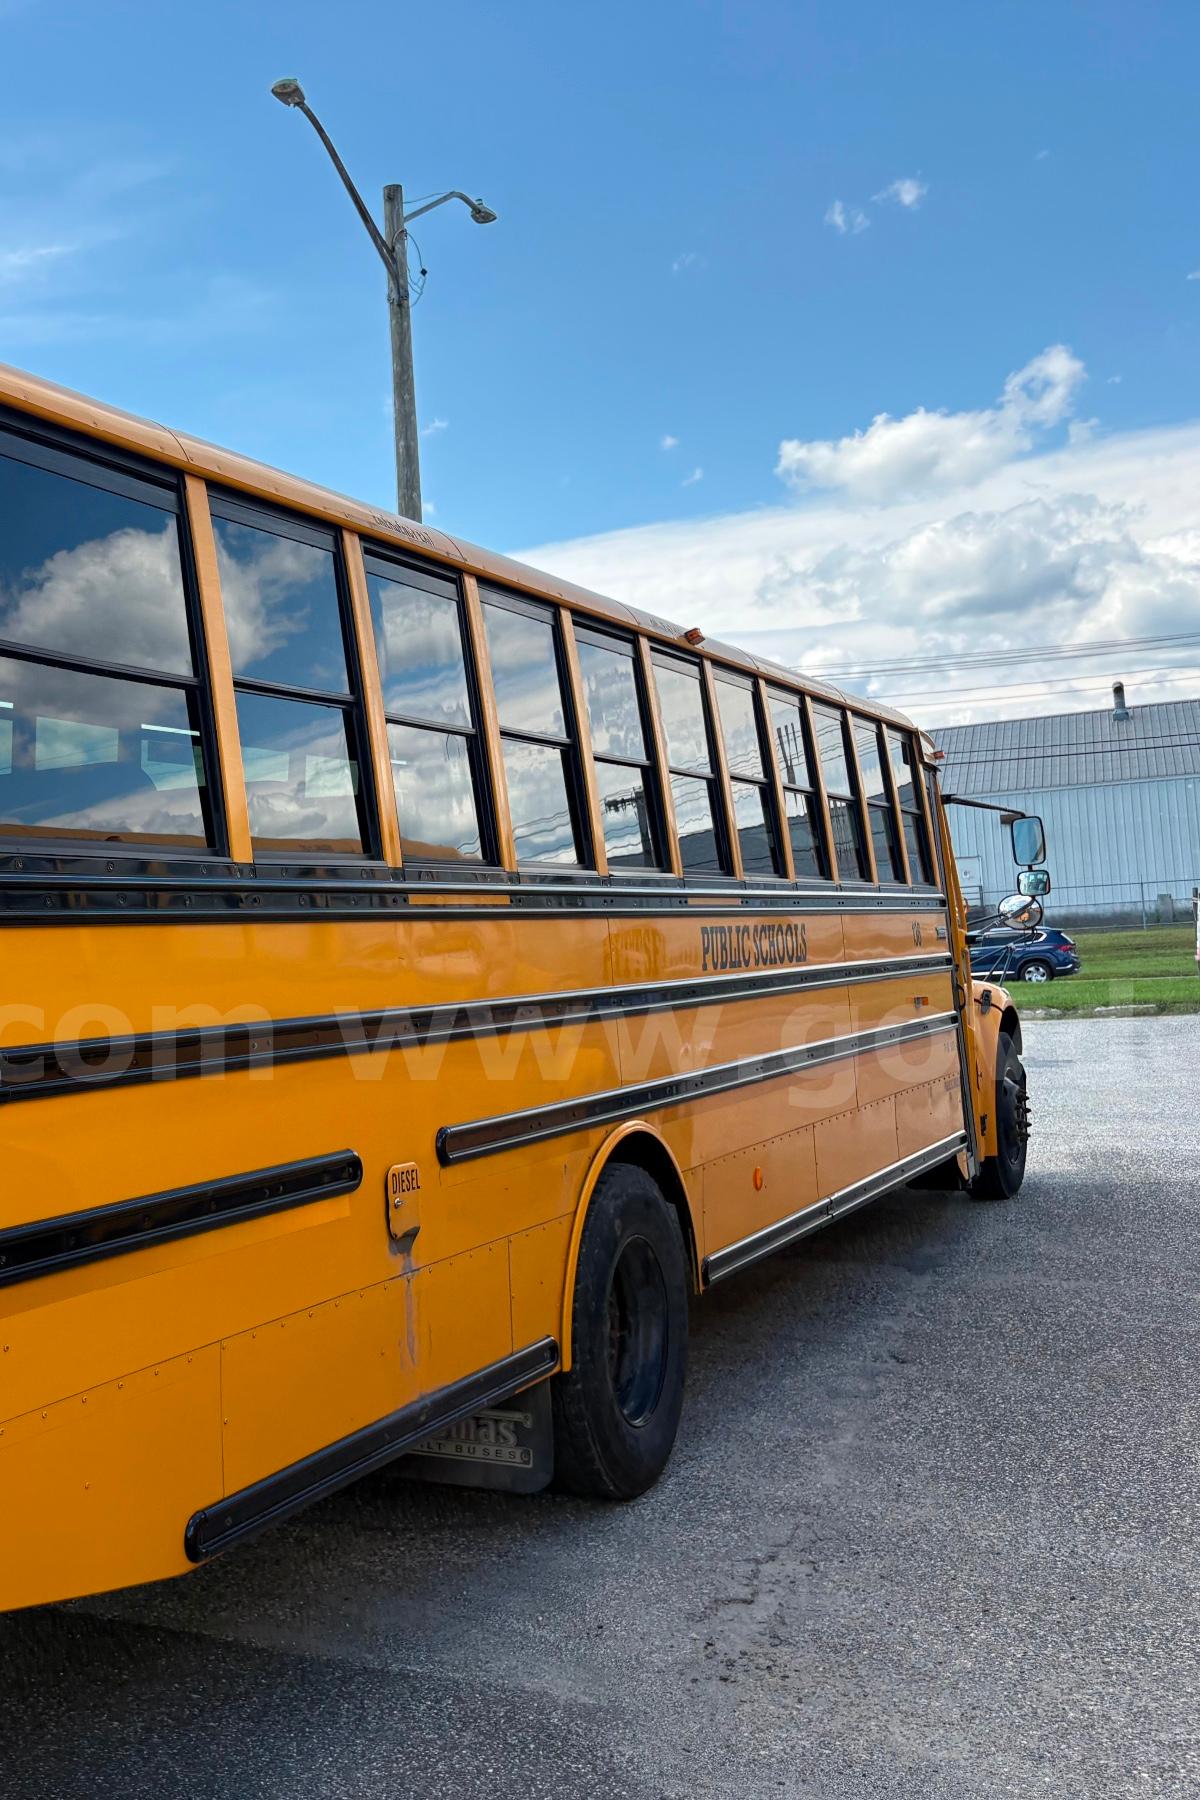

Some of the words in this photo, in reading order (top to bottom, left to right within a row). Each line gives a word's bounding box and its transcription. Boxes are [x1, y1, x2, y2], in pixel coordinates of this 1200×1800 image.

[701, 925, 751, 971] PUBLIC
[752, 923, 807, 967] SCHOOLS
[391, 1168, 421, 1194] DIESEL
